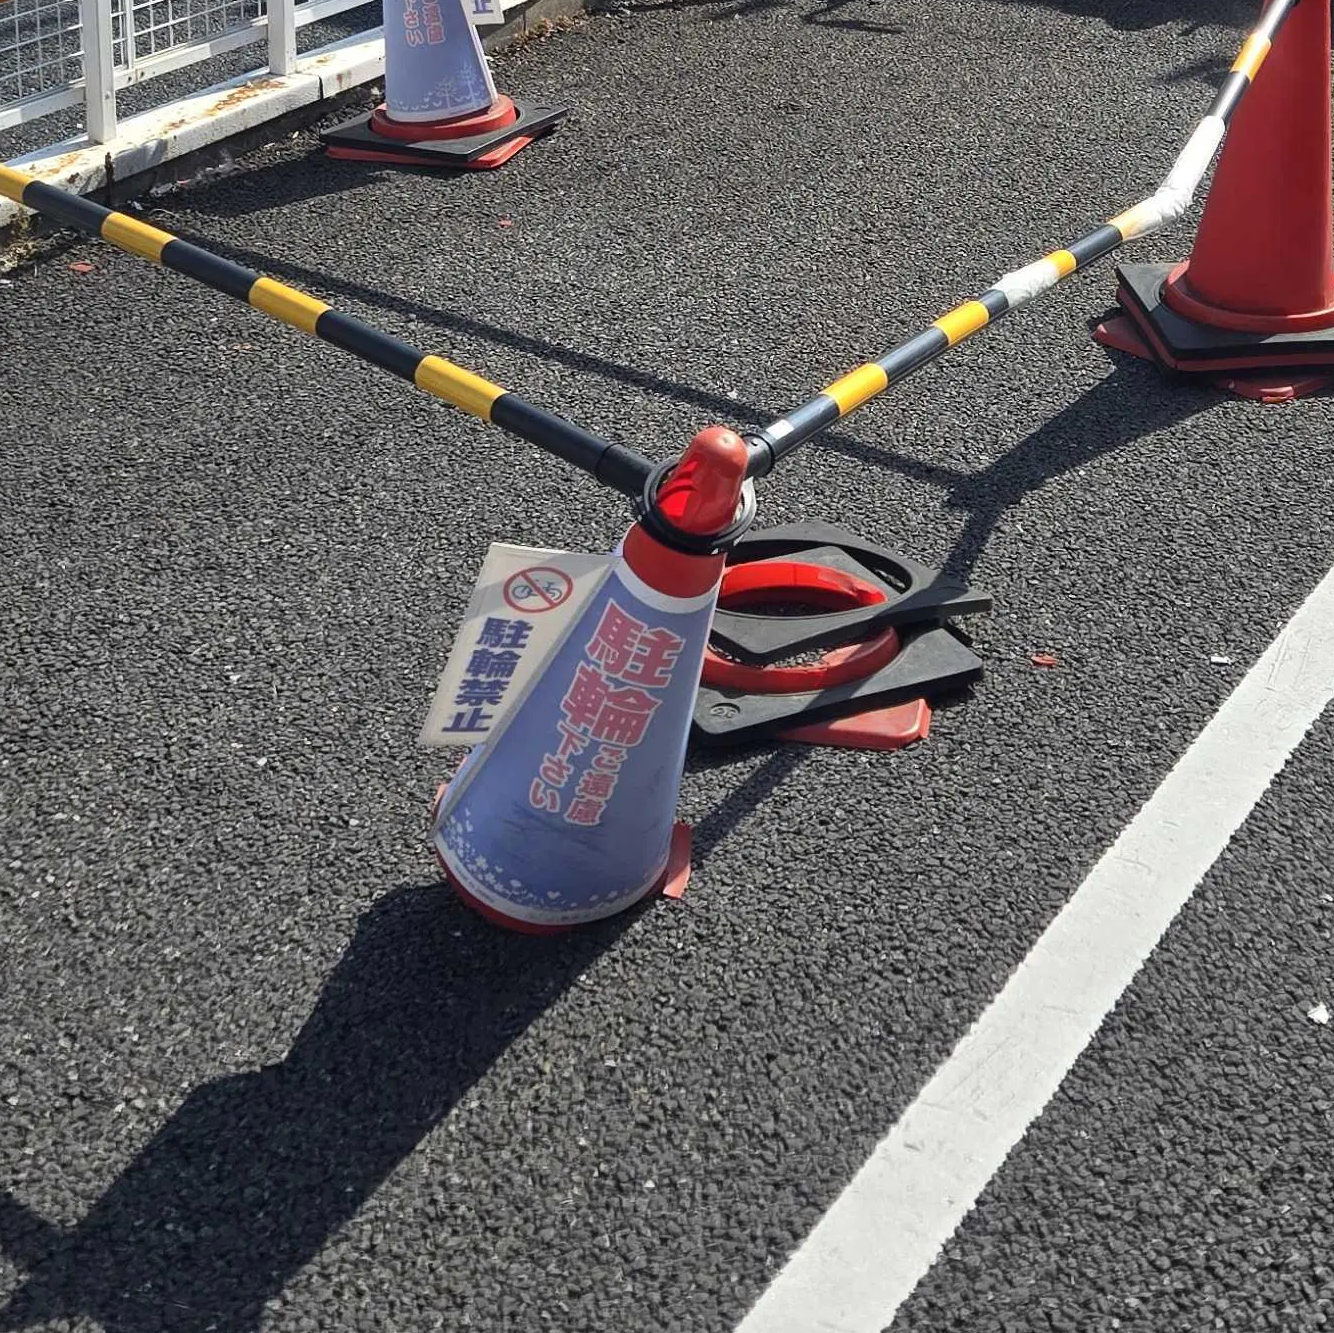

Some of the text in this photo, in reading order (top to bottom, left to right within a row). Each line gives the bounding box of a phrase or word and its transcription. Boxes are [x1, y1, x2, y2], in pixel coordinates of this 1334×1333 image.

[441, 617, 534, 733] 駐輪禁止
[560, 598, 686, 747] 駐輪
[529, 719, 589, 813] 下さい
[564, 743, 627, 826] ご遠慮
